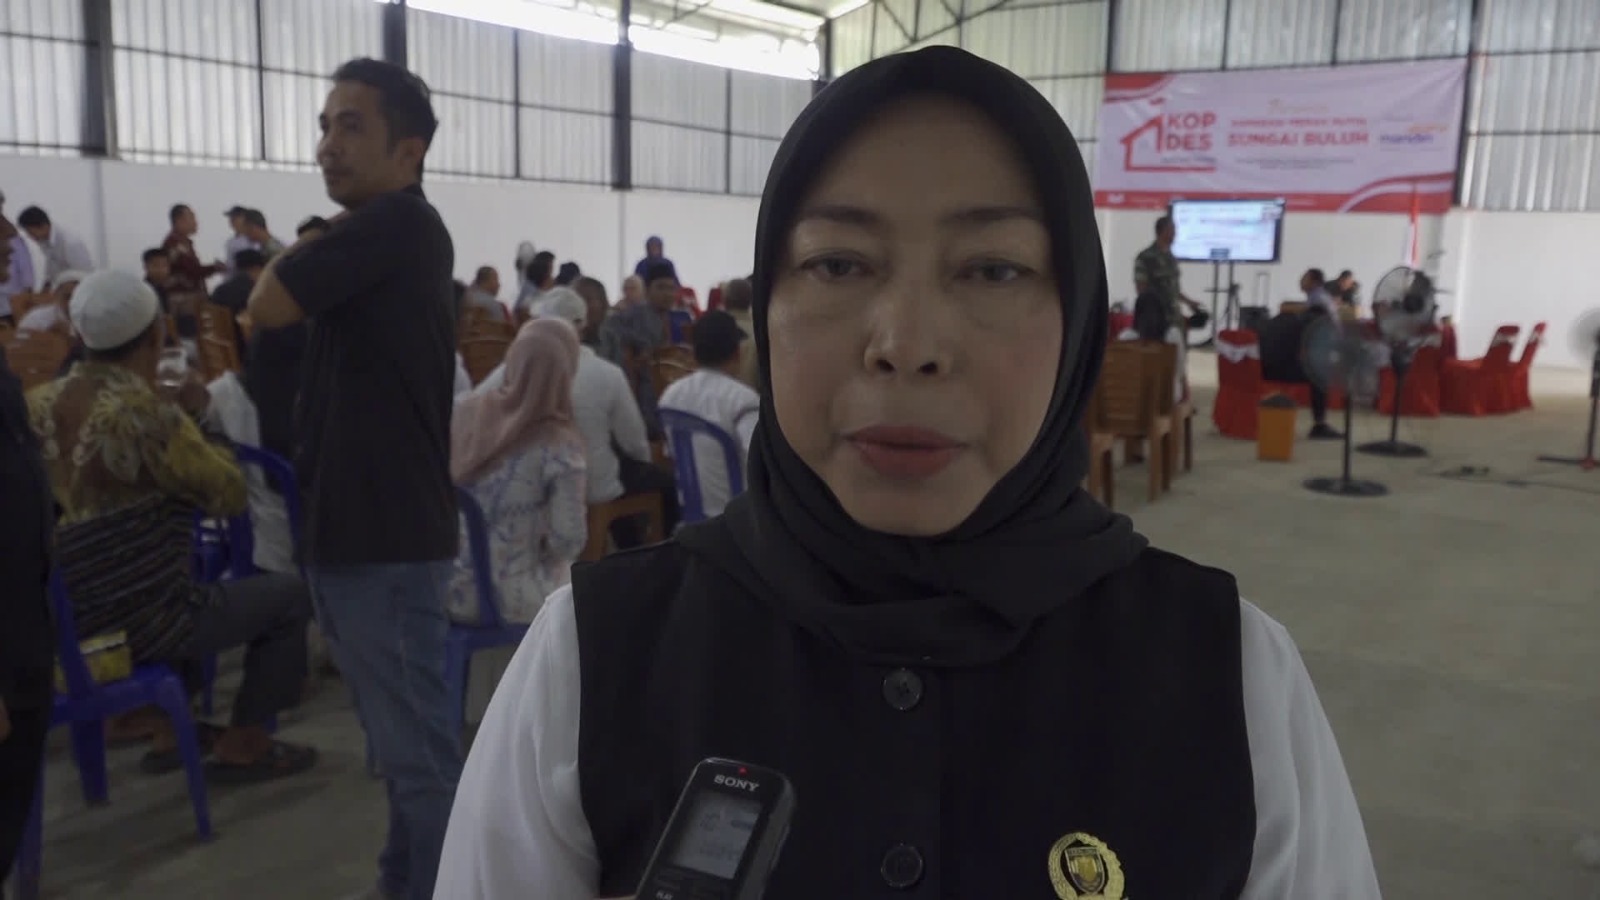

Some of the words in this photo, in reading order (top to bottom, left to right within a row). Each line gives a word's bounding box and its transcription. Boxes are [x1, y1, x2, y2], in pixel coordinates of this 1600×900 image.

[1167, 110, 1216, 129] KOP
[1167, 132, 1214, 152] DES
[1227, 131, 1299, 148] SUNGAI
[1303, 130, 1369, 147] BULUH
[714, 774, 760, 792] SONY
